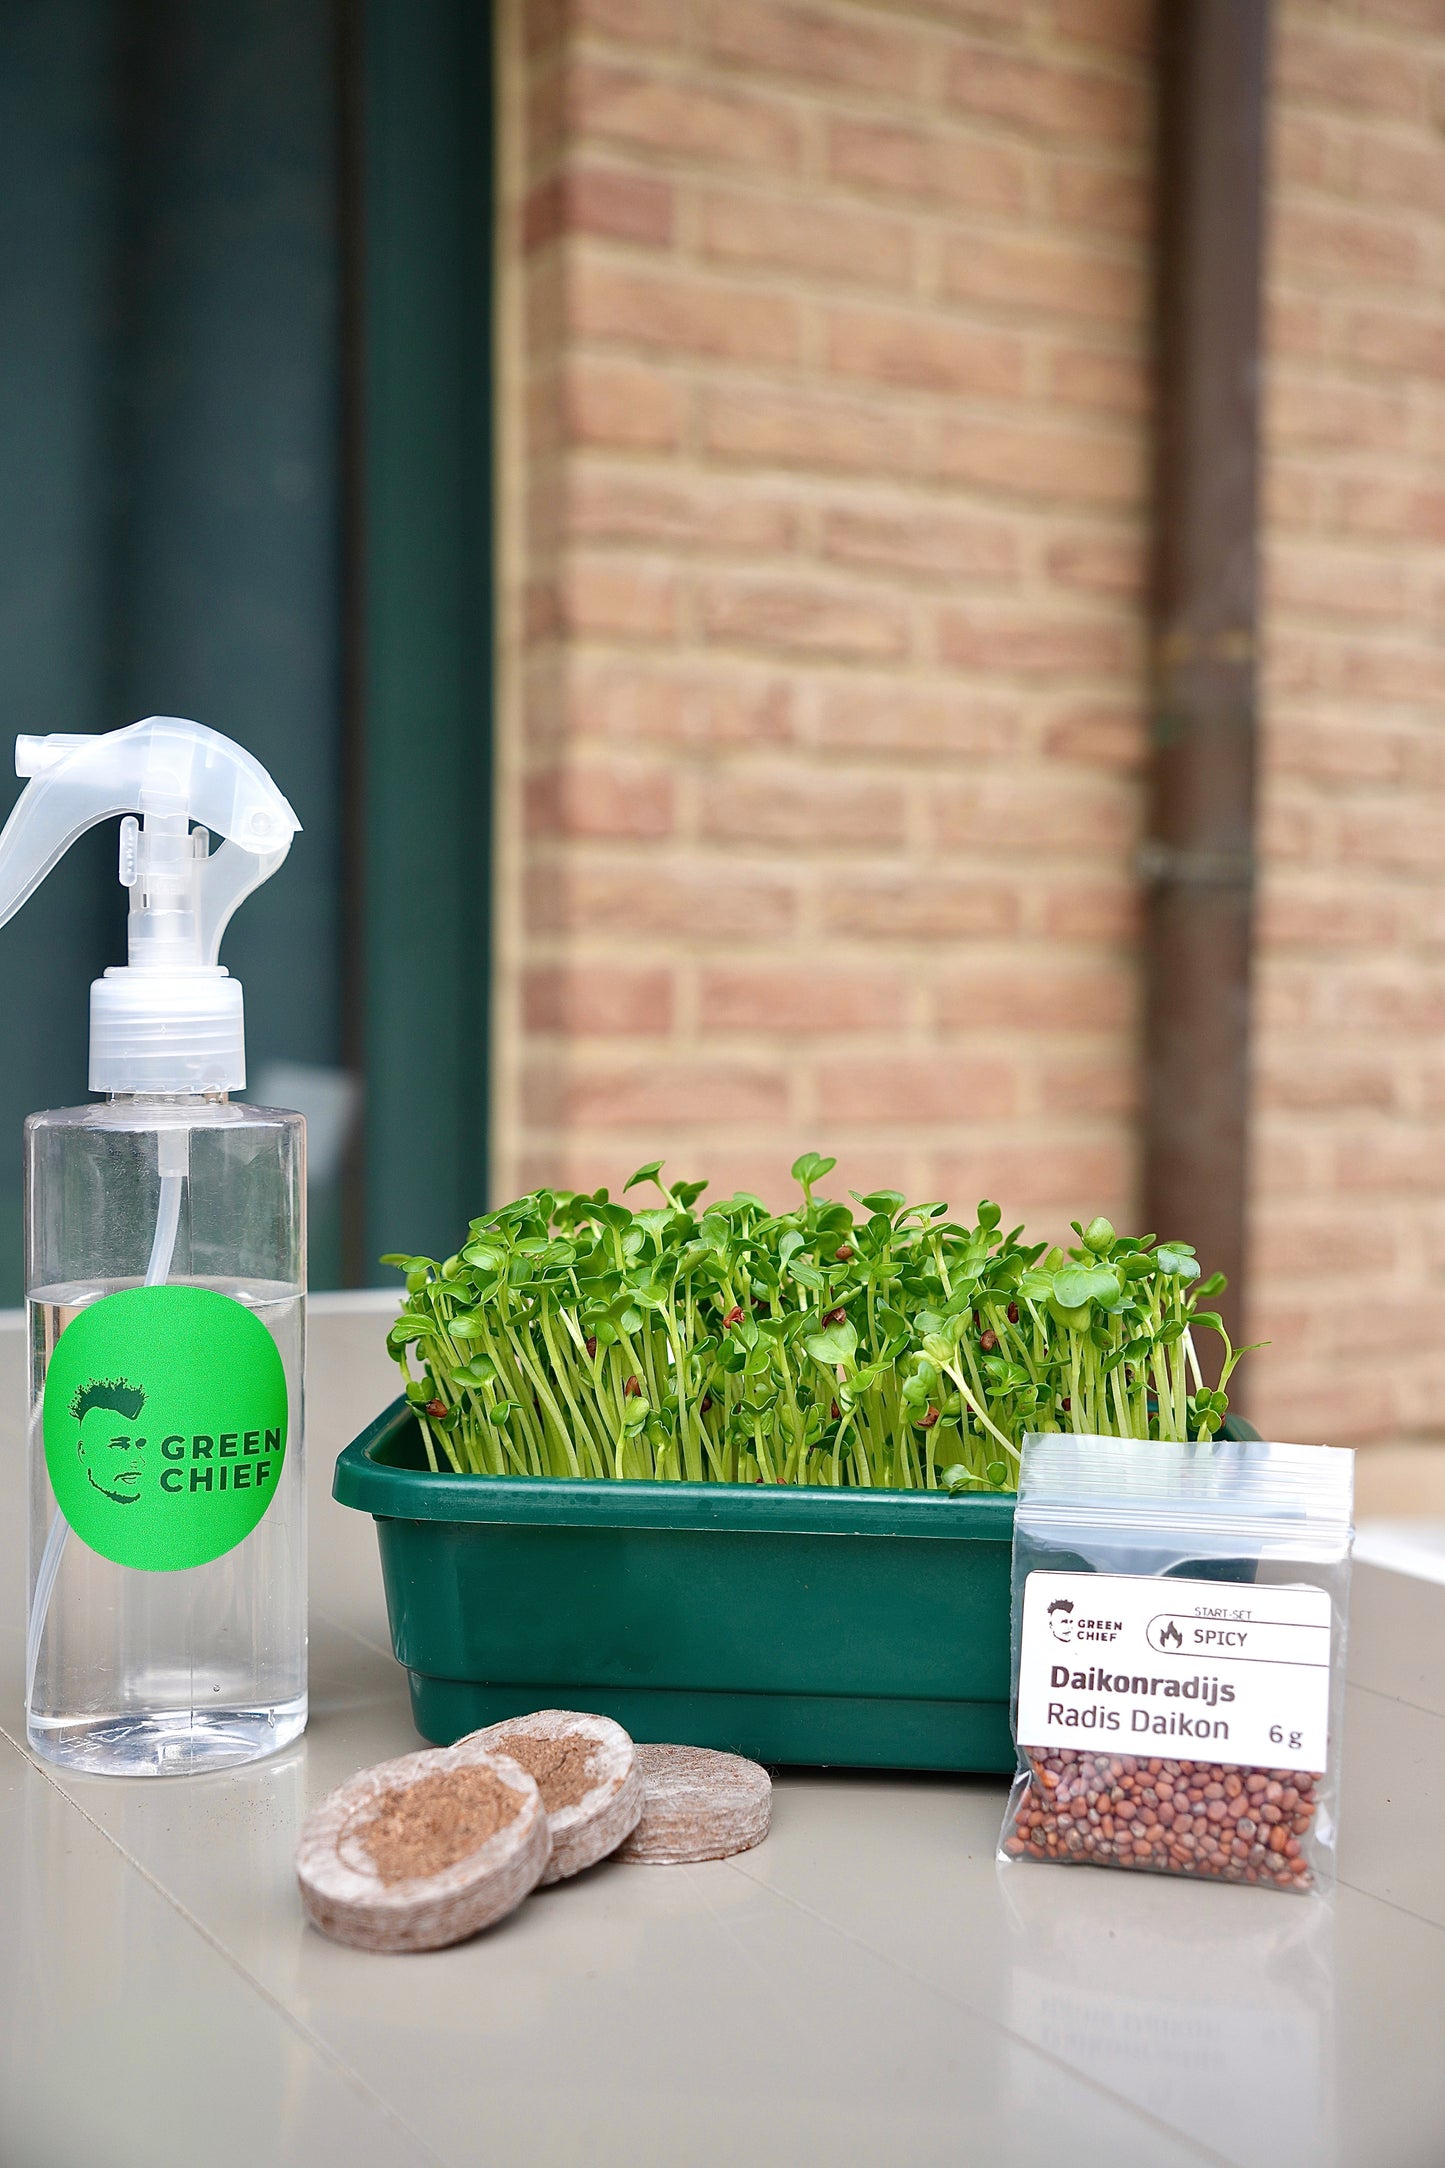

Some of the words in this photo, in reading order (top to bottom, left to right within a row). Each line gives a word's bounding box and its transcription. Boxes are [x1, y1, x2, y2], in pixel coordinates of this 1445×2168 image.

[161, 1427, 281, 1460] GREEN
[160, 1460, 271, 1493] CHIEF
[1077, 1619, 1123, 1631] GREEN
[1195, 1606, 1252, 1620] START-SET
[1077, 1630, 1117, 1642] CHIEF
[1194, 1629, 1248, 1647] SPICY
[1050, 1665, 1236, 1706] Daikonradijs
[1047, 1702, 1121, 1731] Radis
[1131, 1709, 1229, 1740] Daikon
[1269, 1725, 1283, 1744] 6
[1289, 1731, 1303, 1750] g
